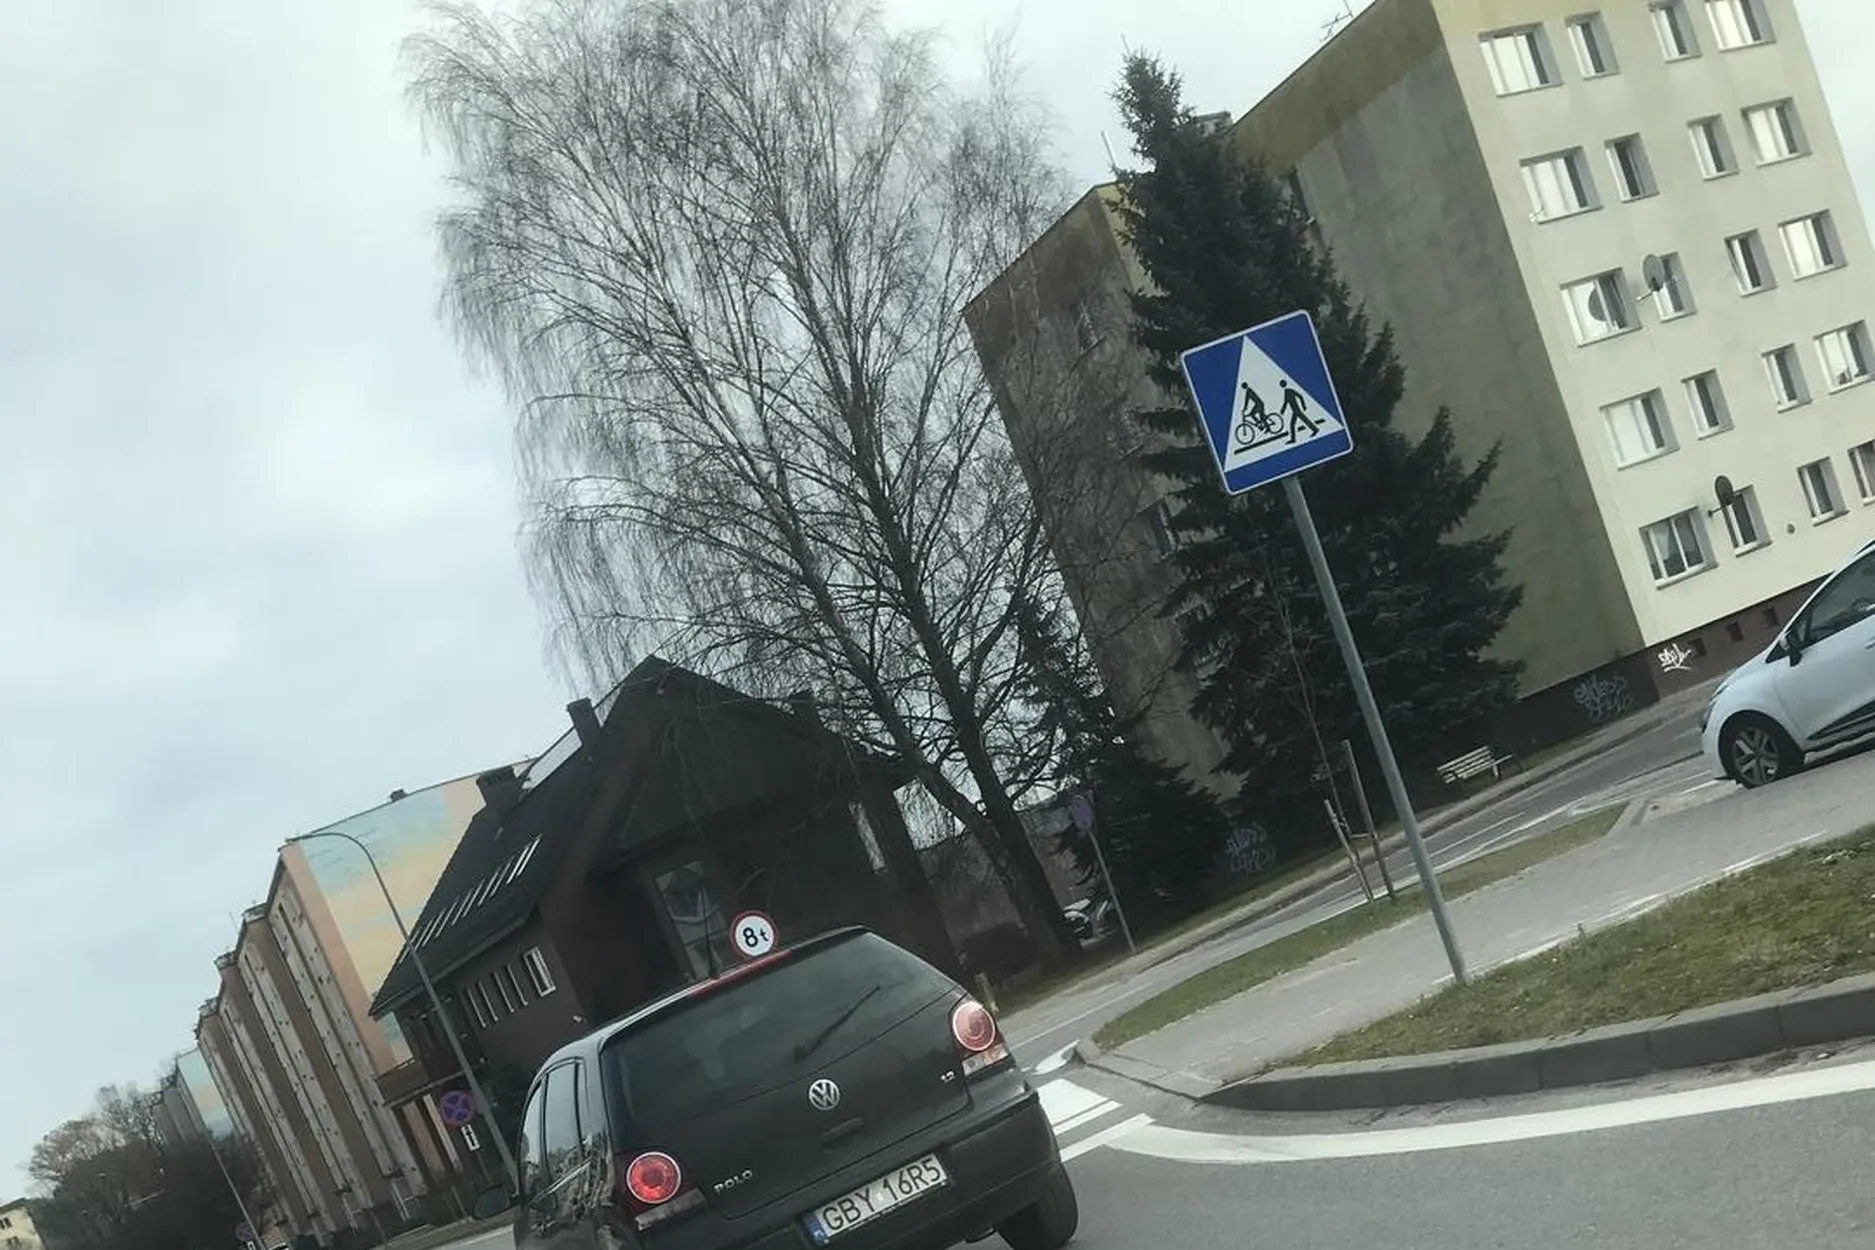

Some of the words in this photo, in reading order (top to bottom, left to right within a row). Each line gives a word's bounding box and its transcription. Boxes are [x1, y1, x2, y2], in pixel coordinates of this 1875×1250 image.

[809, 1079, 840, 1110] VW
[822, 1187, 876, 1231] GBY
[883, 1157, 941, 1202] 16R5
